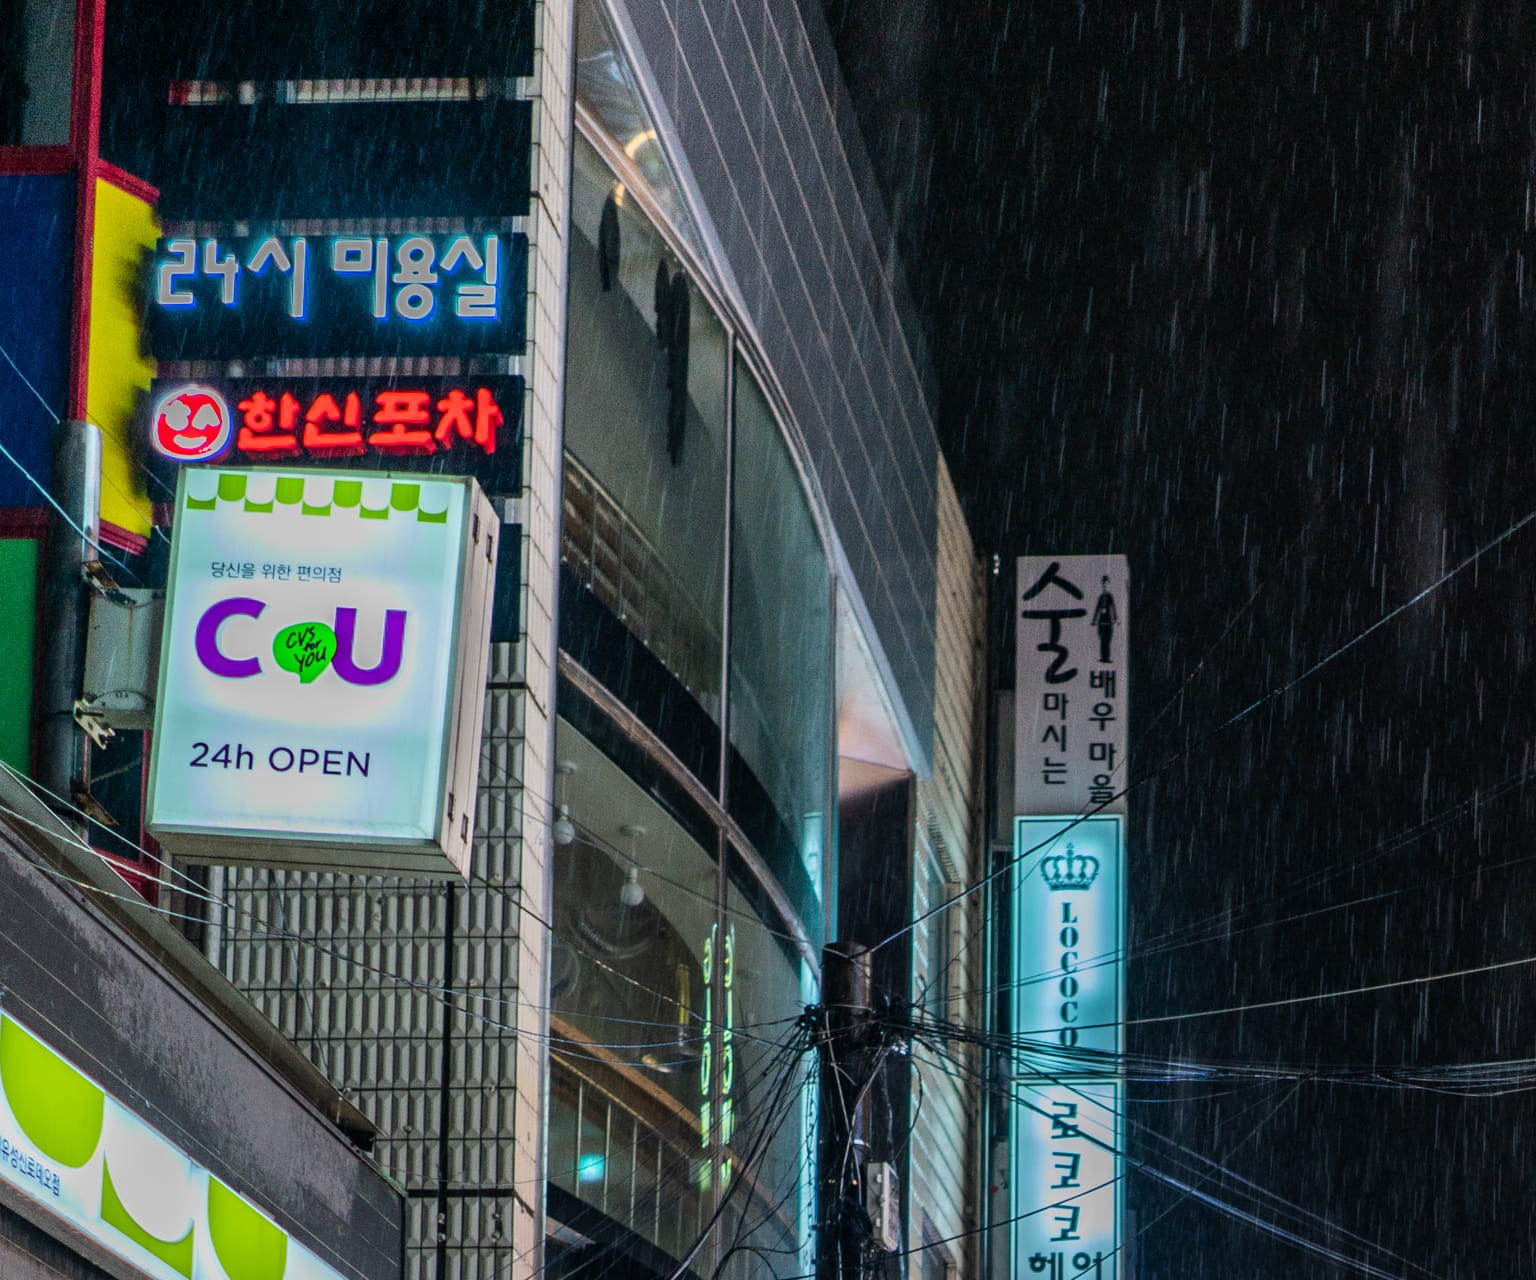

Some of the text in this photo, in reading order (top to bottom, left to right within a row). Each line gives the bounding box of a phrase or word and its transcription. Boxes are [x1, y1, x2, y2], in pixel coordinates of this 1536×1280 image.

[157, 235, 501, 321] 24시 미용실
[236, 388, 506, 456] 한신포차
[210, 560, 343, 584] 당신을 위한 편의점
[194, 597, 408, 687] CU
[292, 646, 330, 672] YOU
[1021, 561, 1088, 684] 술
[189, 741, 371, 778] 24h OPEN
[1041, 692, 1069, 786] 마시는
[1087, 668, 1118, 806] 배우 마을
[1058, 901, 1080, 1049] LOCOCO
[1049, 1100, 1082, 1244] 로코코
